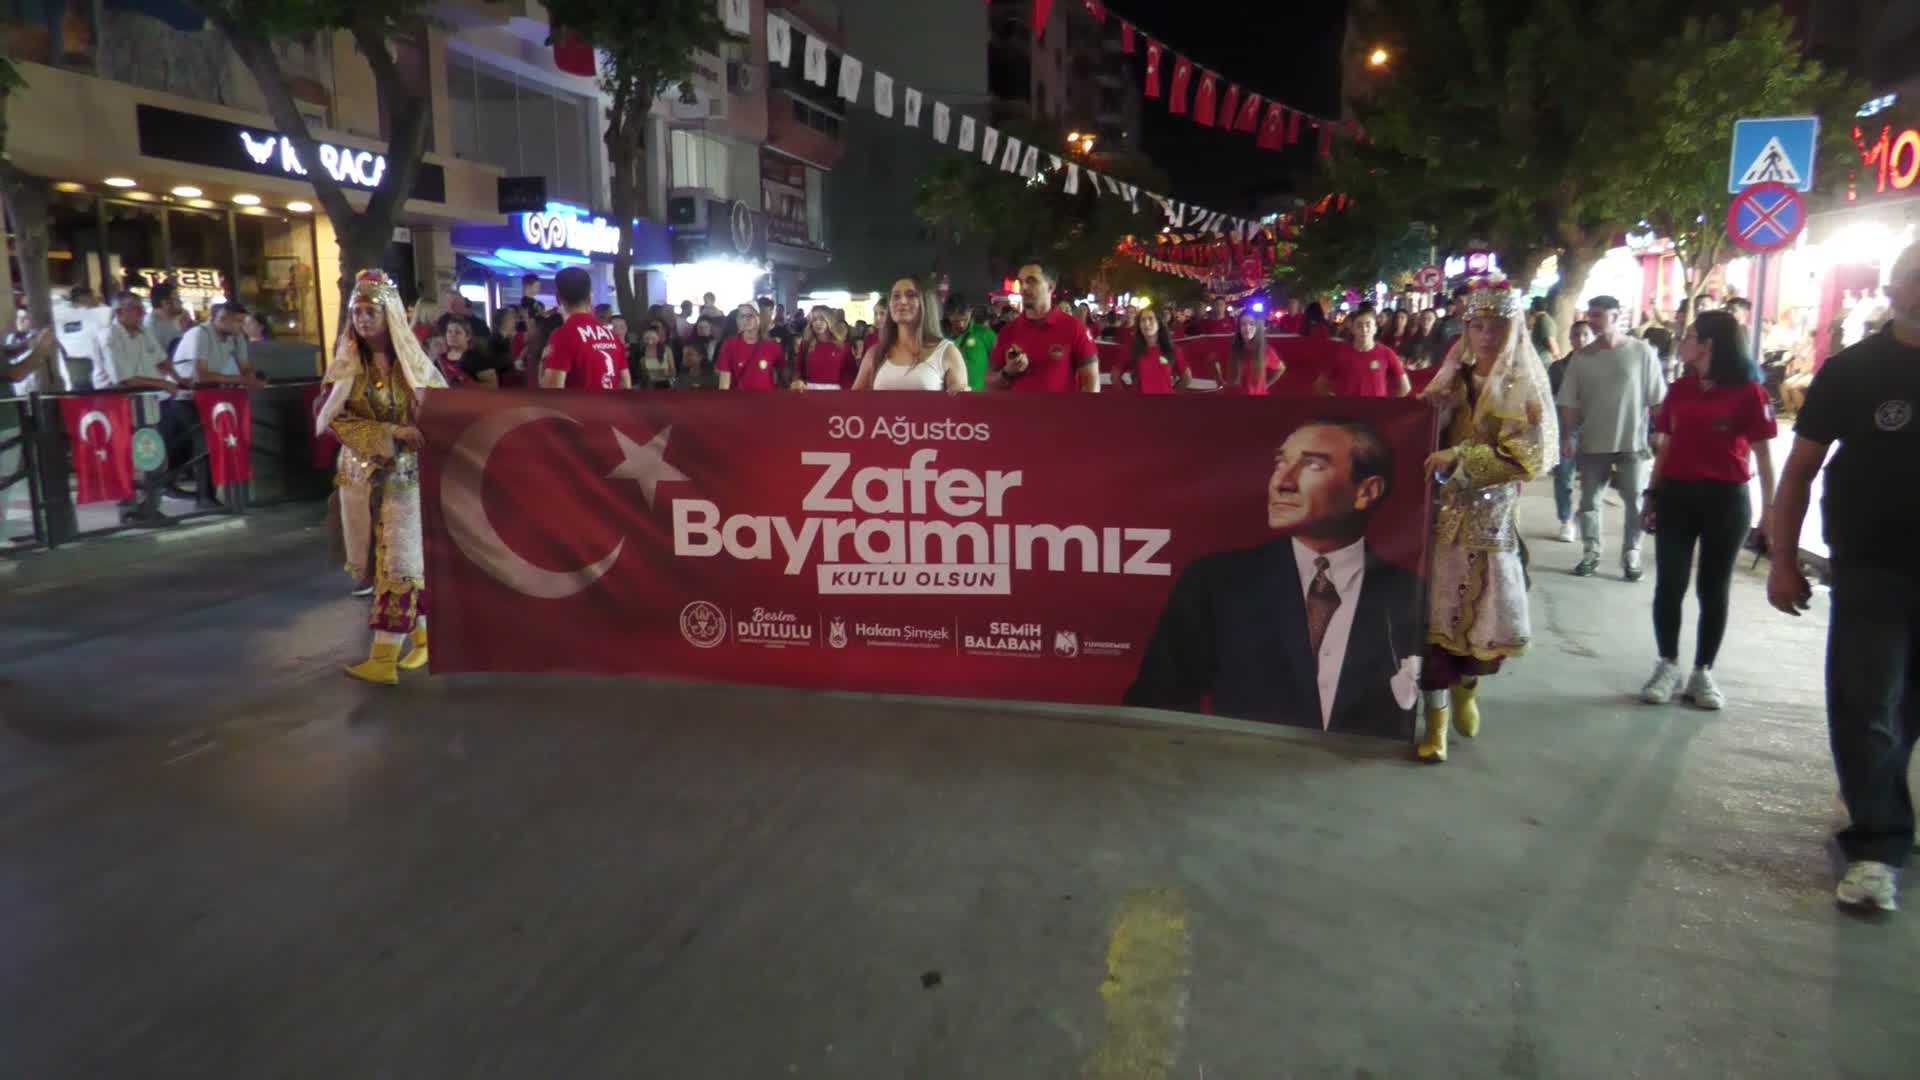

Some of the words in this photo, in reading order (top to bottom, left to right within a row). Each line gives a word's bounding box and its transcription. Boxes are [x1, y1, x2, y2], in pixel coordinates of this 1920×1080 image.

[281, 136, 386, 187] KRAC
[828, 415, 865, 439] 30
[870, 415, 991, 446] Ağustos
[800, 448, 1023, 517] Zafer
[672, 498, 1172, 576] Bayramımız
[831, 571, 906, 587] KUTLU
[916, 572, 996, 588] OLSUN
[751, 607, 797, 622] Besim
[737, 621, 812, 639] DUTLULU
[855, 623, 901, 637] Hakan
[903, 625, 949, 640] Şimşek
[964, 635, 1042, 651] BALABAN
